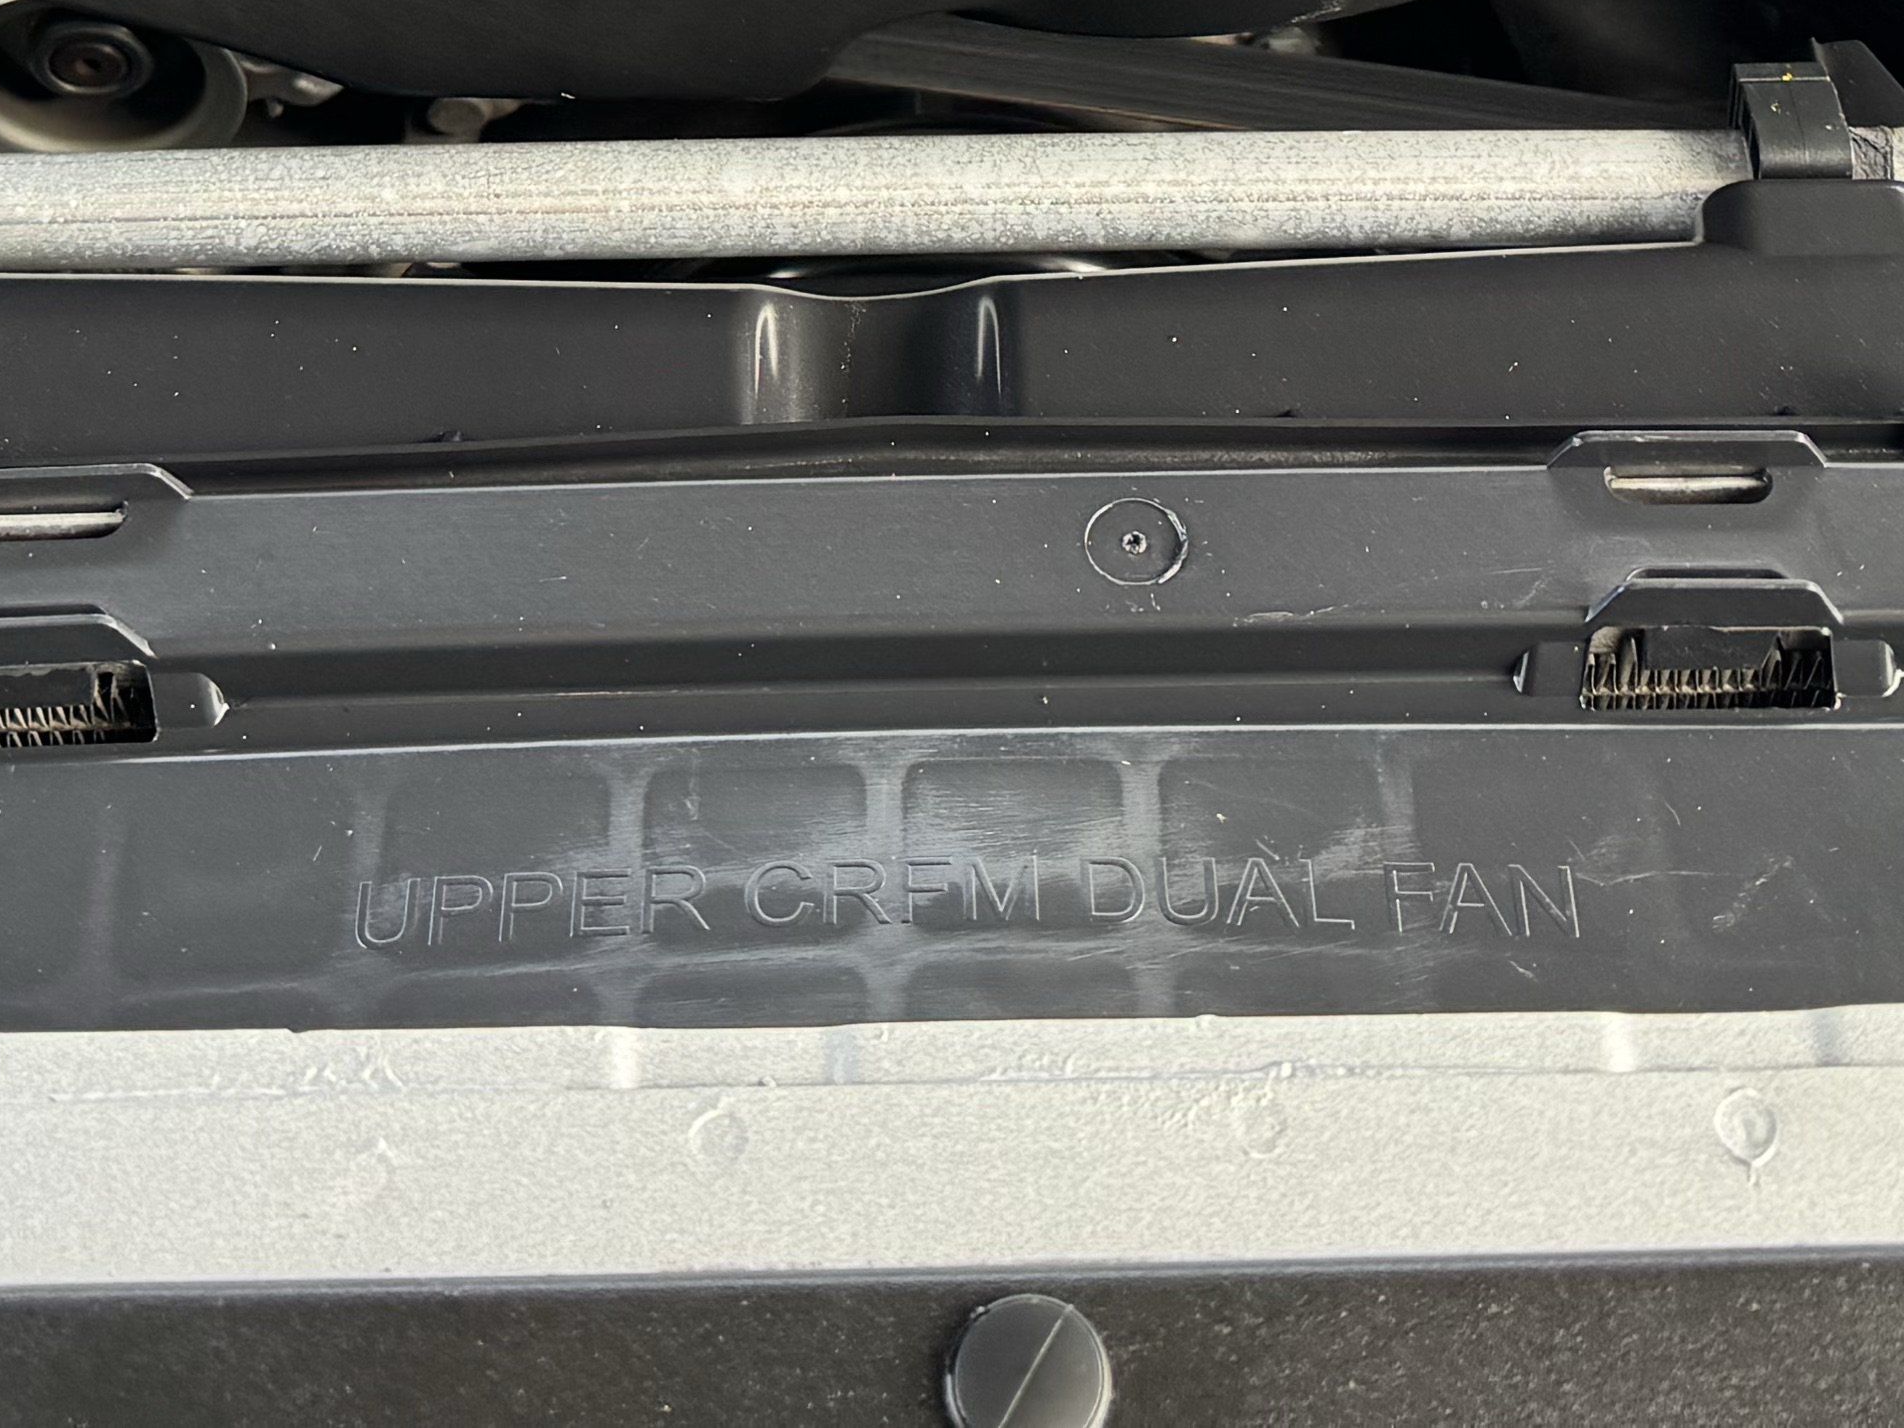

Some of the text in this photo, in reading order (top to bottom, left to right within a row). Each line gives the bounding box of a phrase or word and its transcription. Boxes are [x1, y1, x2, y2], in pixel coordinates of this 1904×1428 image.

[355, 855, 1580, 950] UPPER CRFM DUAL FAN
